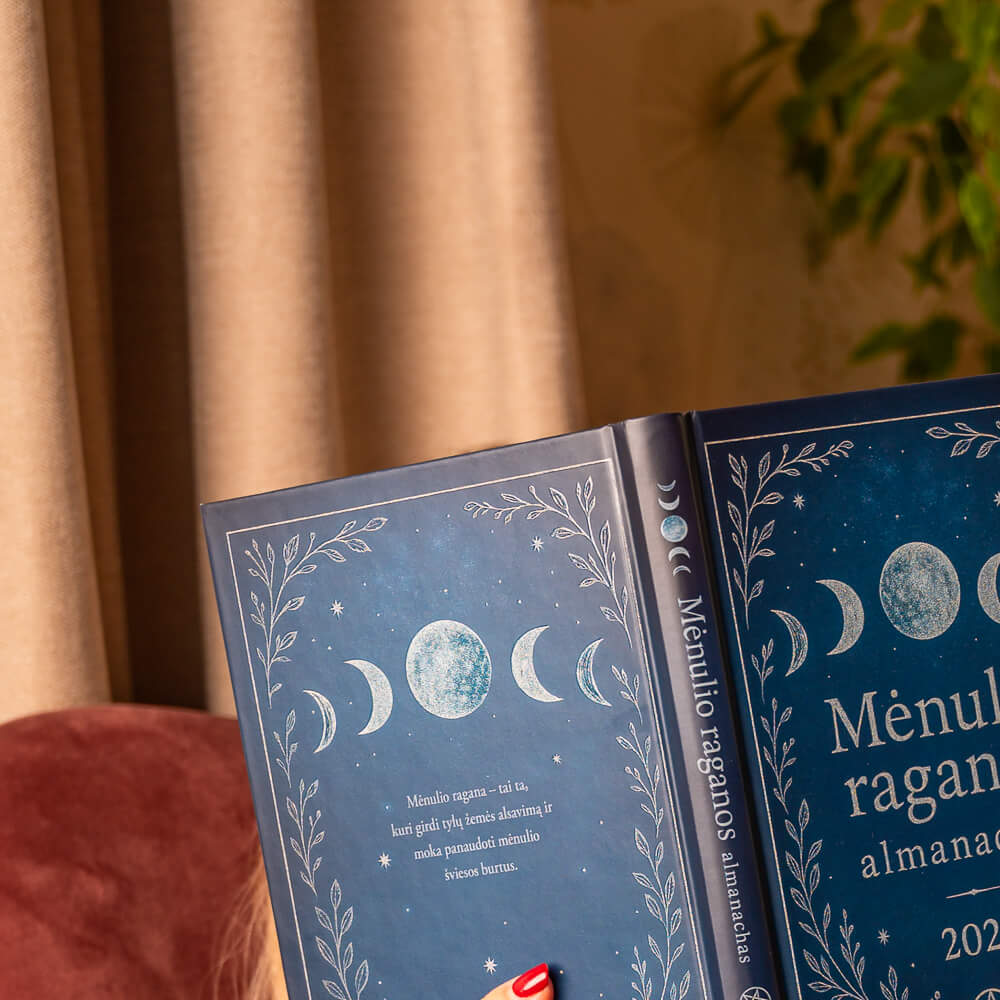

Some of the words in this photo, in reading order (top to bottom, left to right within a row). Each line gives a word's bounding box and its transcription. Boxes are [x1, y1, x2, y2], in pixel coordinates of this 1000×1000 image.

[678, 595, 719, 719] Mėnulio
[406, 790, 449, 808] Mėnulio
[453, 788, 487, 804] ragana
[499, 781, 512, 793] tai
[515, 781, 529, 793] ta,
[697, 727, 736, 840] raganos
[391, 823, 413, 837] kuri
[416, 818, 440, 837] girdi
[442, 815, 464, 832] tylų
[497, 804, 543, 820] alsavimą
[544, 801, 552, 813] ir
[415, 844, 442, 859] moka
[445, 837, 496, 859] panaudoti
[499, 830, 541, 846] mėnulio
[480, 862, 518, 875] burtus.
[722, 852, 752, 964] almanachas
